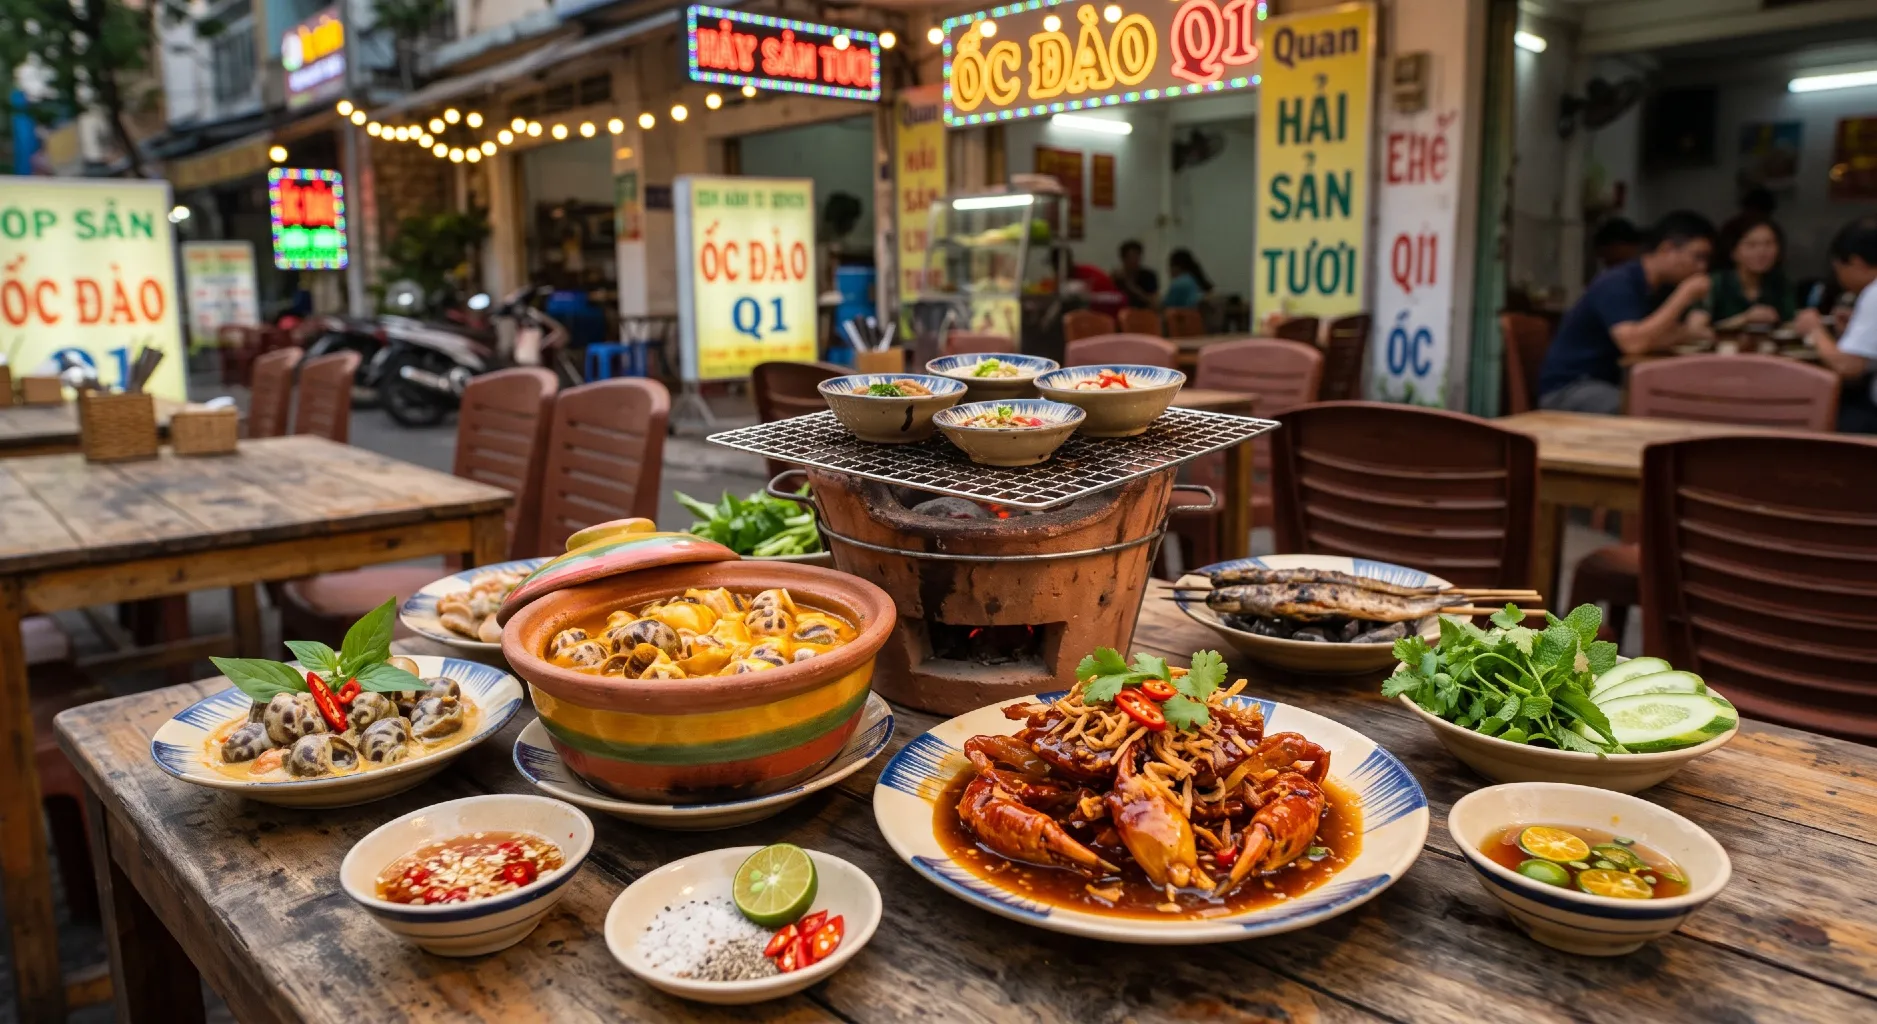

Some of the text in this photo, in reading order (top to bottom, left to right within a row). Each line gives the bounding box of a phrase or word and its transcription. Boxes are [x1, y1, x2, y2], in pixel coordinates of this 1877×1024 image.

[951, 20, 1021, 111] ỐC
[1170, 0, 1259, 85] Q1
[1272, 26, 1360, 68] Quan
[1277, 73, 1348, 146] HẢI
[1269, 151, 1353, 221] SẢN
[701, 220, 741, 283] ỐC
[1262, 238, 1356, 296] TƯƠI
[1, 255, 60, 326] ỐC
[732, 296, 789, 341] Q1
[1387, 310, 1433, 378] ỐC
